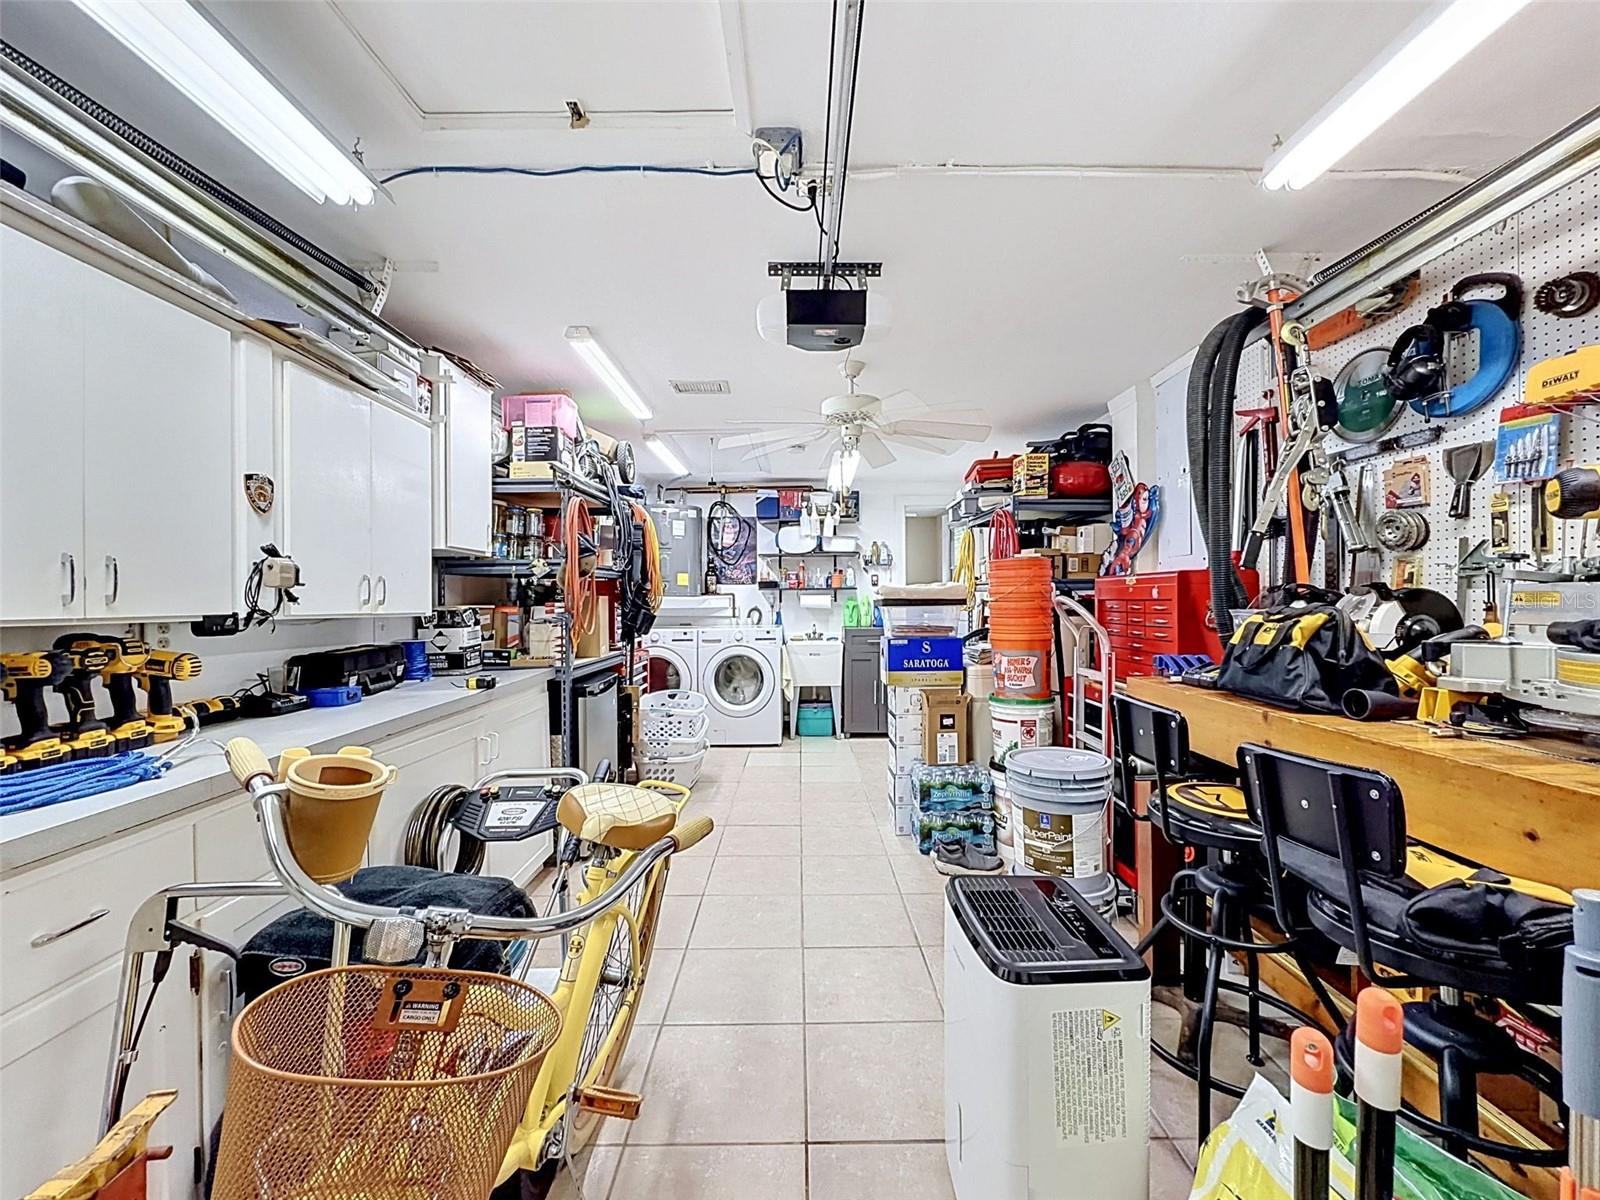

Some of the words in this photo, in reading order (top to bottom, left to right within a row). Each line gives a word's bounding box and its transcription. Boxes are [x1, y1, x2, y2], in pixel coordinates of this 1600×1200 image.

[921, 640, 932, 654] S
[903, 659, 949, 668] SARATOGA
[1007, 674, 1027, 682] BUCKET
[1024, 826, 1073, 841] SuperPaint
